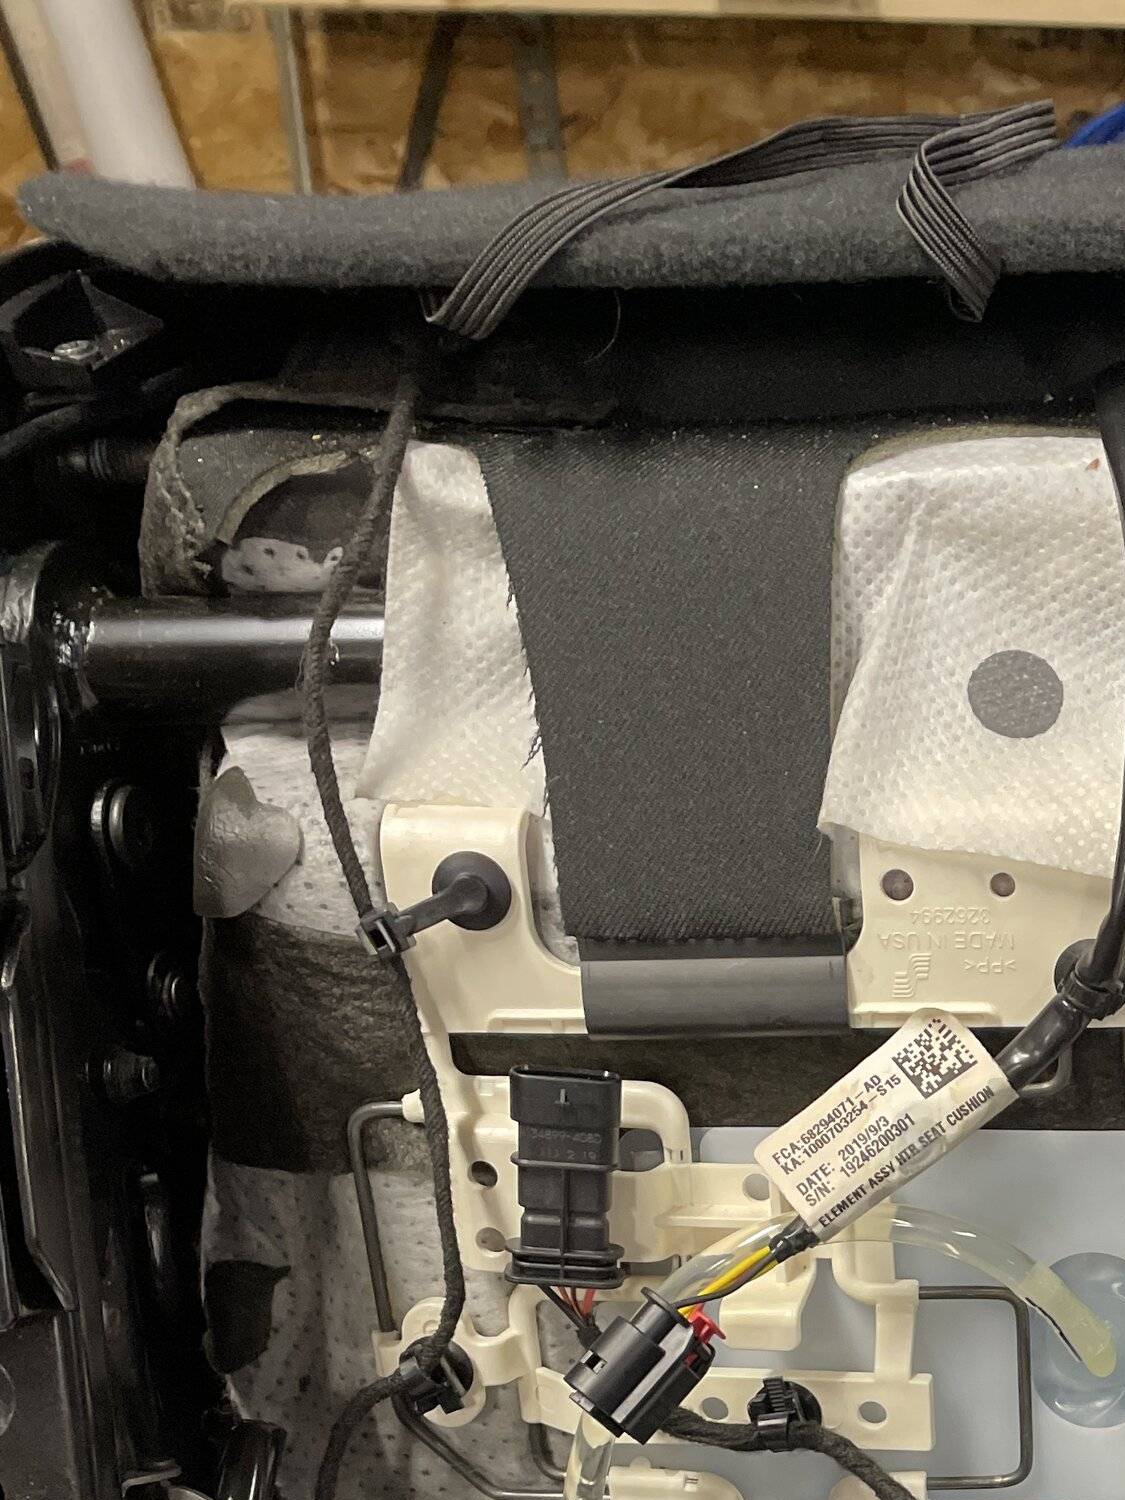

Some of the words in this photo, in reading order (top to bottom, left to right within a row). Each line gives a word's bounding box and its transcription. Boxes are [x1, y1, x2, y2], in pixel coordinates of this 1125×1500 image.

[876, 931, 921, 950] USA
[925, 931, 948, 951] IN
[953, 930, 1015, 951] MADE
[796, 1161, 836, 1196] DATE:
[838, 1115, 890, 1159] 2019/9/3
[805, 1180, 835, 1207] S/N:
[840, 1113, 915, 1179] 19246200301
[819, 1184, 867, 1228] ELEMENT
[868, 1162, 896, 1189] ASSY
[919, 1123, 947, 1152] SEAT
[947, 1086, 995, 1127] CUSHION
